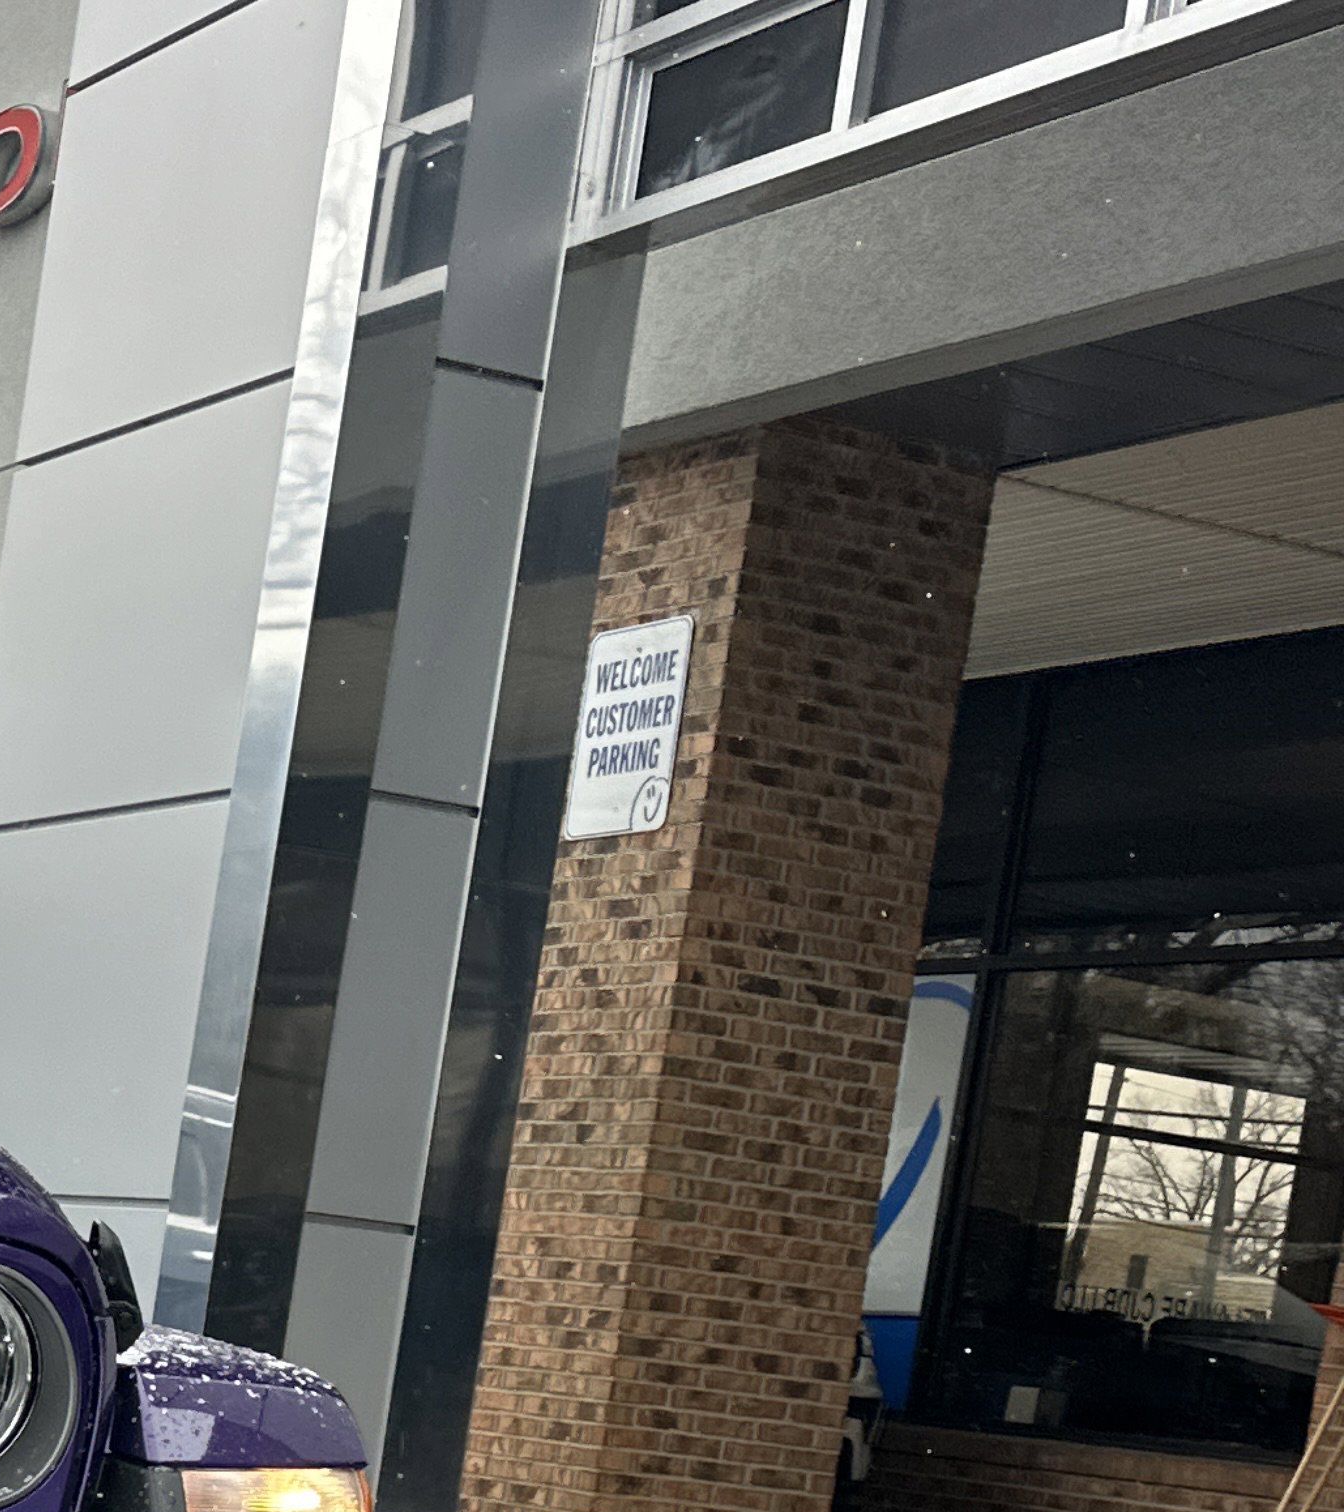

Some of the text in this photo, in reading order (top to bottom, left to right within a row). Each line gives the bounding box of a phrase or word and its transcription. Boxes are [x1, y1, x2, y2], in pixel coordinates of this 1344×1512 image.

[596, 649, 679, 694] WELCOME
[585, 694, 676, 739] CUSTOMER
[587, 738, 660, 778] PARKING
